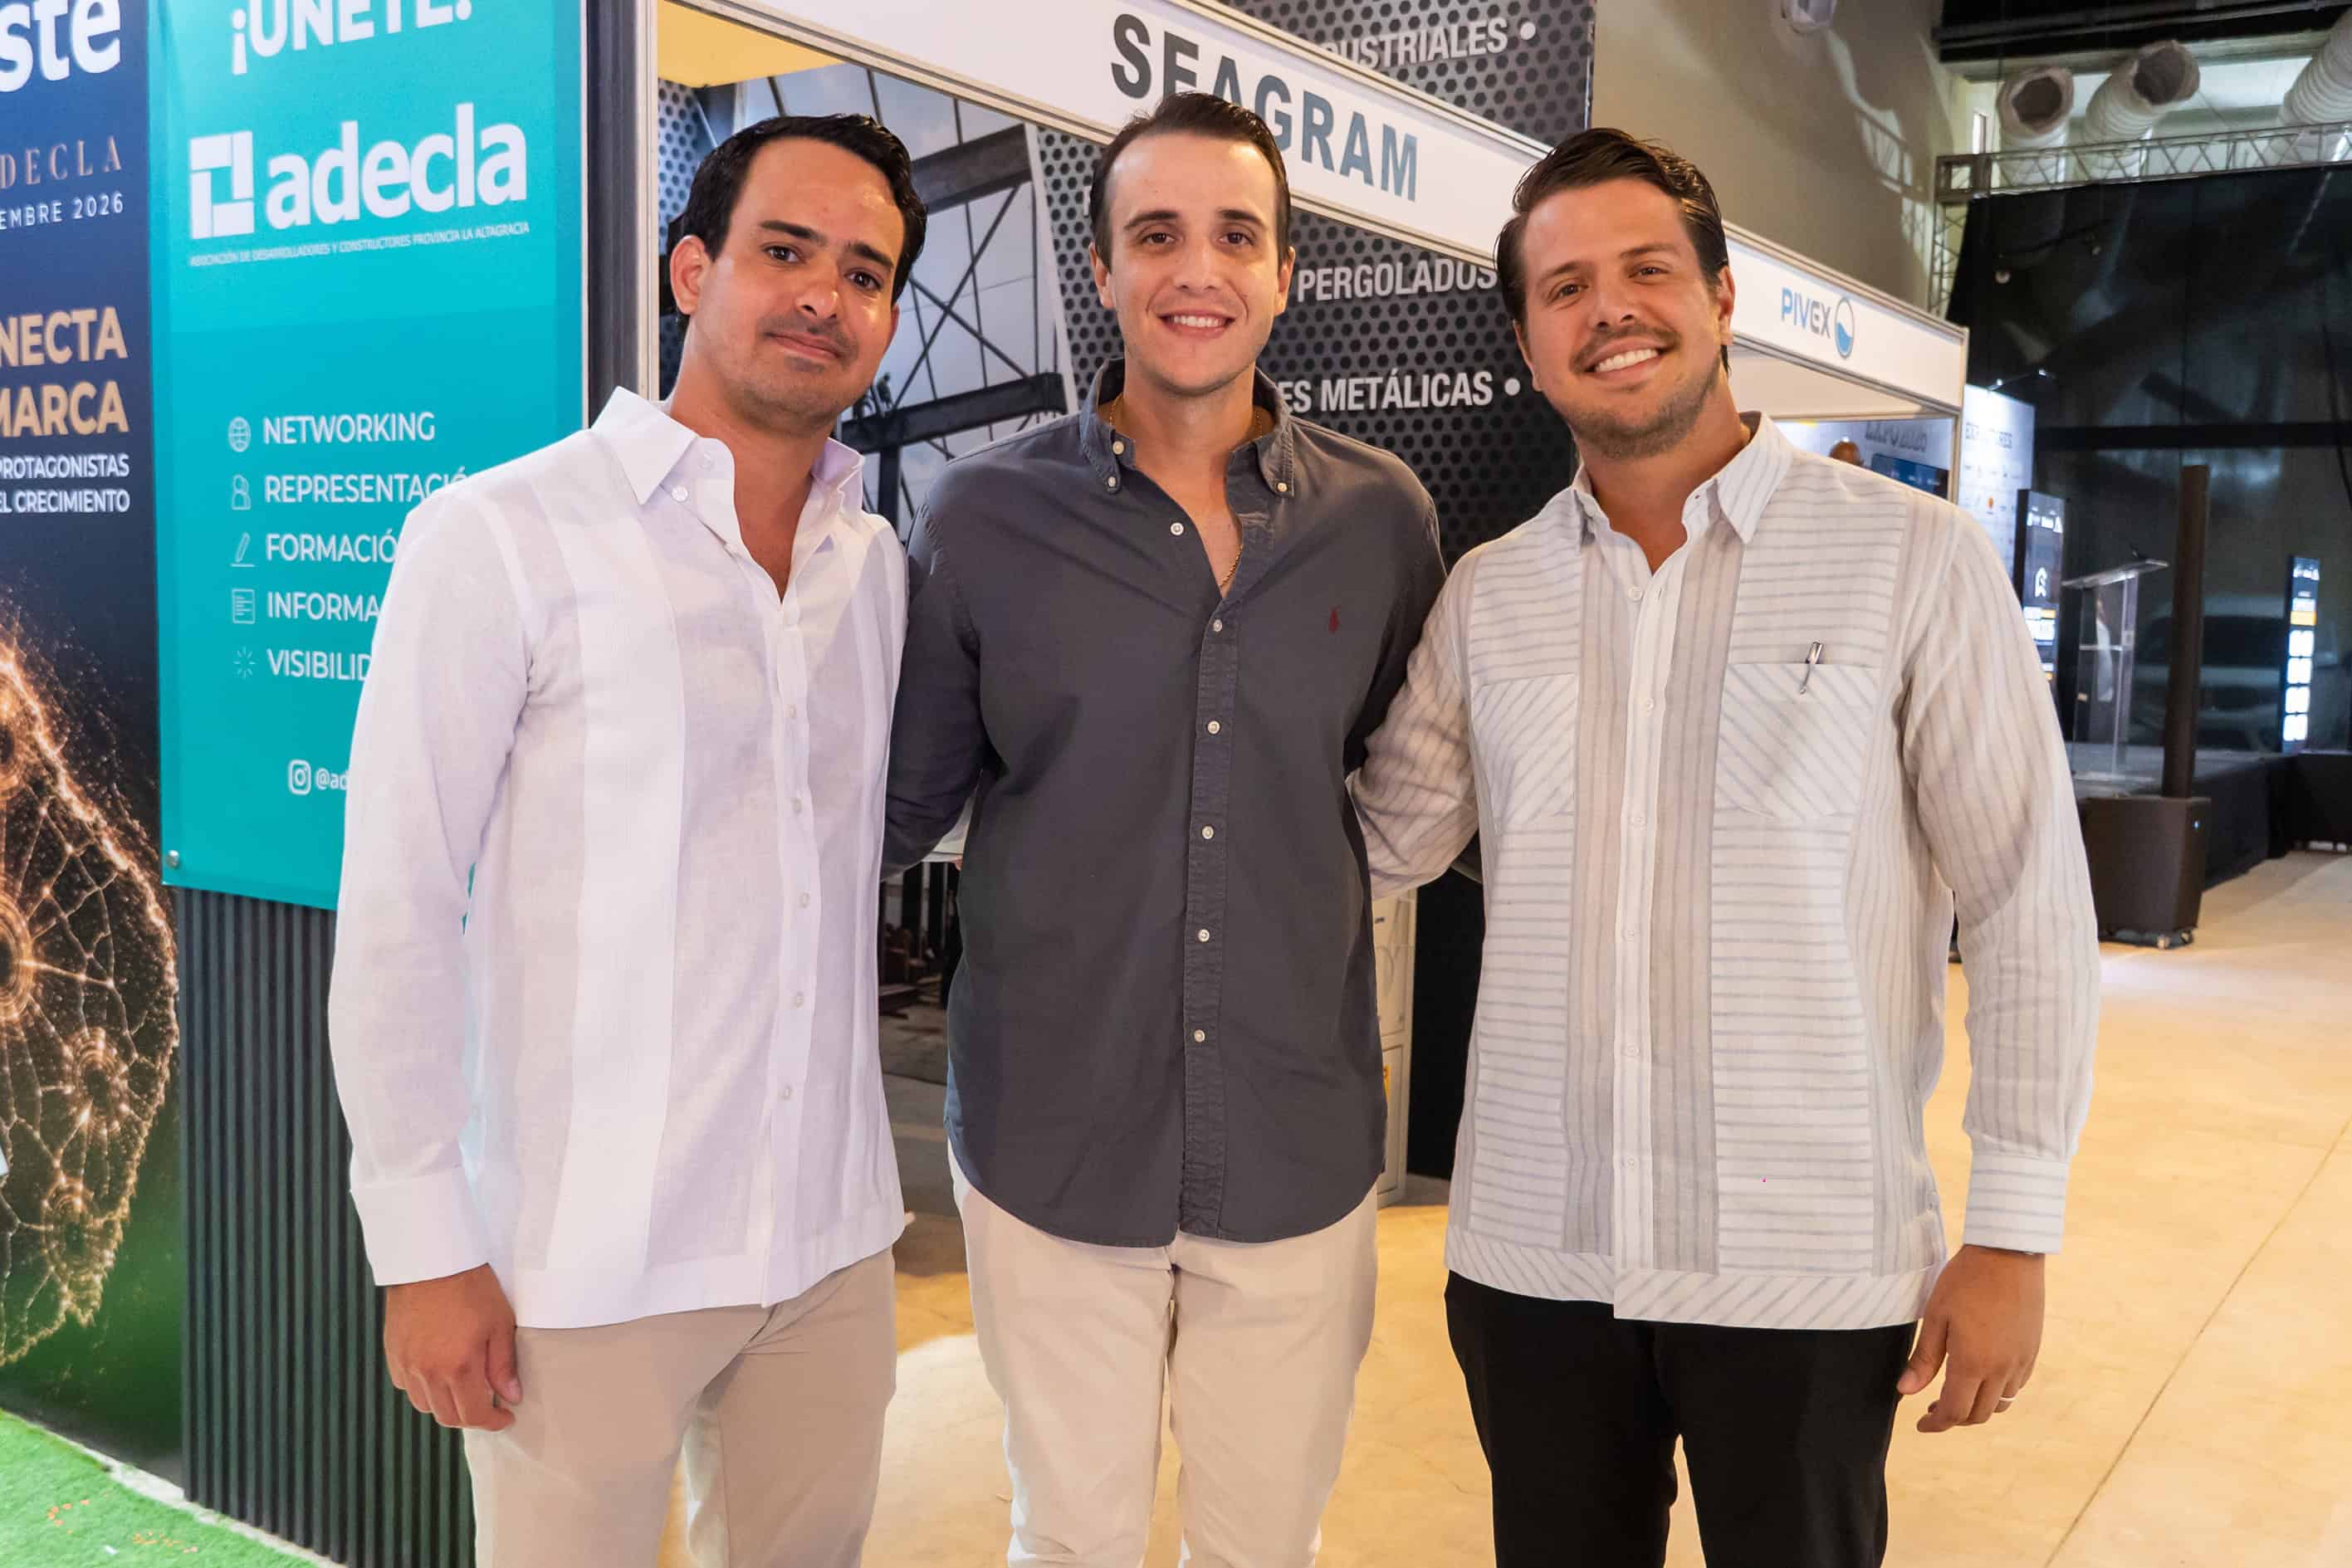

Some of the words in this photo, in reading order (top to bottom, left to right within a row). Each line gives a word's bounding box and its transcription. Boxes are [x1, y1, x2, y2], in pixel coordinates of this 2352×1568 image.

[1111, 13, 1418, 203] SEAGRAM
[266, 102, 527, 231] adecla
[72, 191, 123, 219] 2026
[1297, 258, 1499, 303] PERGOLADOS
[1781, 286, 1831, 339] PIVEX
[1320, 369, 1494, 412] METÁLICAS
[263, 412, 436, 444] NETWORKING
[0, 453, 130, 479] ROTAGONISTAS
[15, 489, 130, 513] CRECIMIENTO
[267, 591, 381, 623] INFORMA
